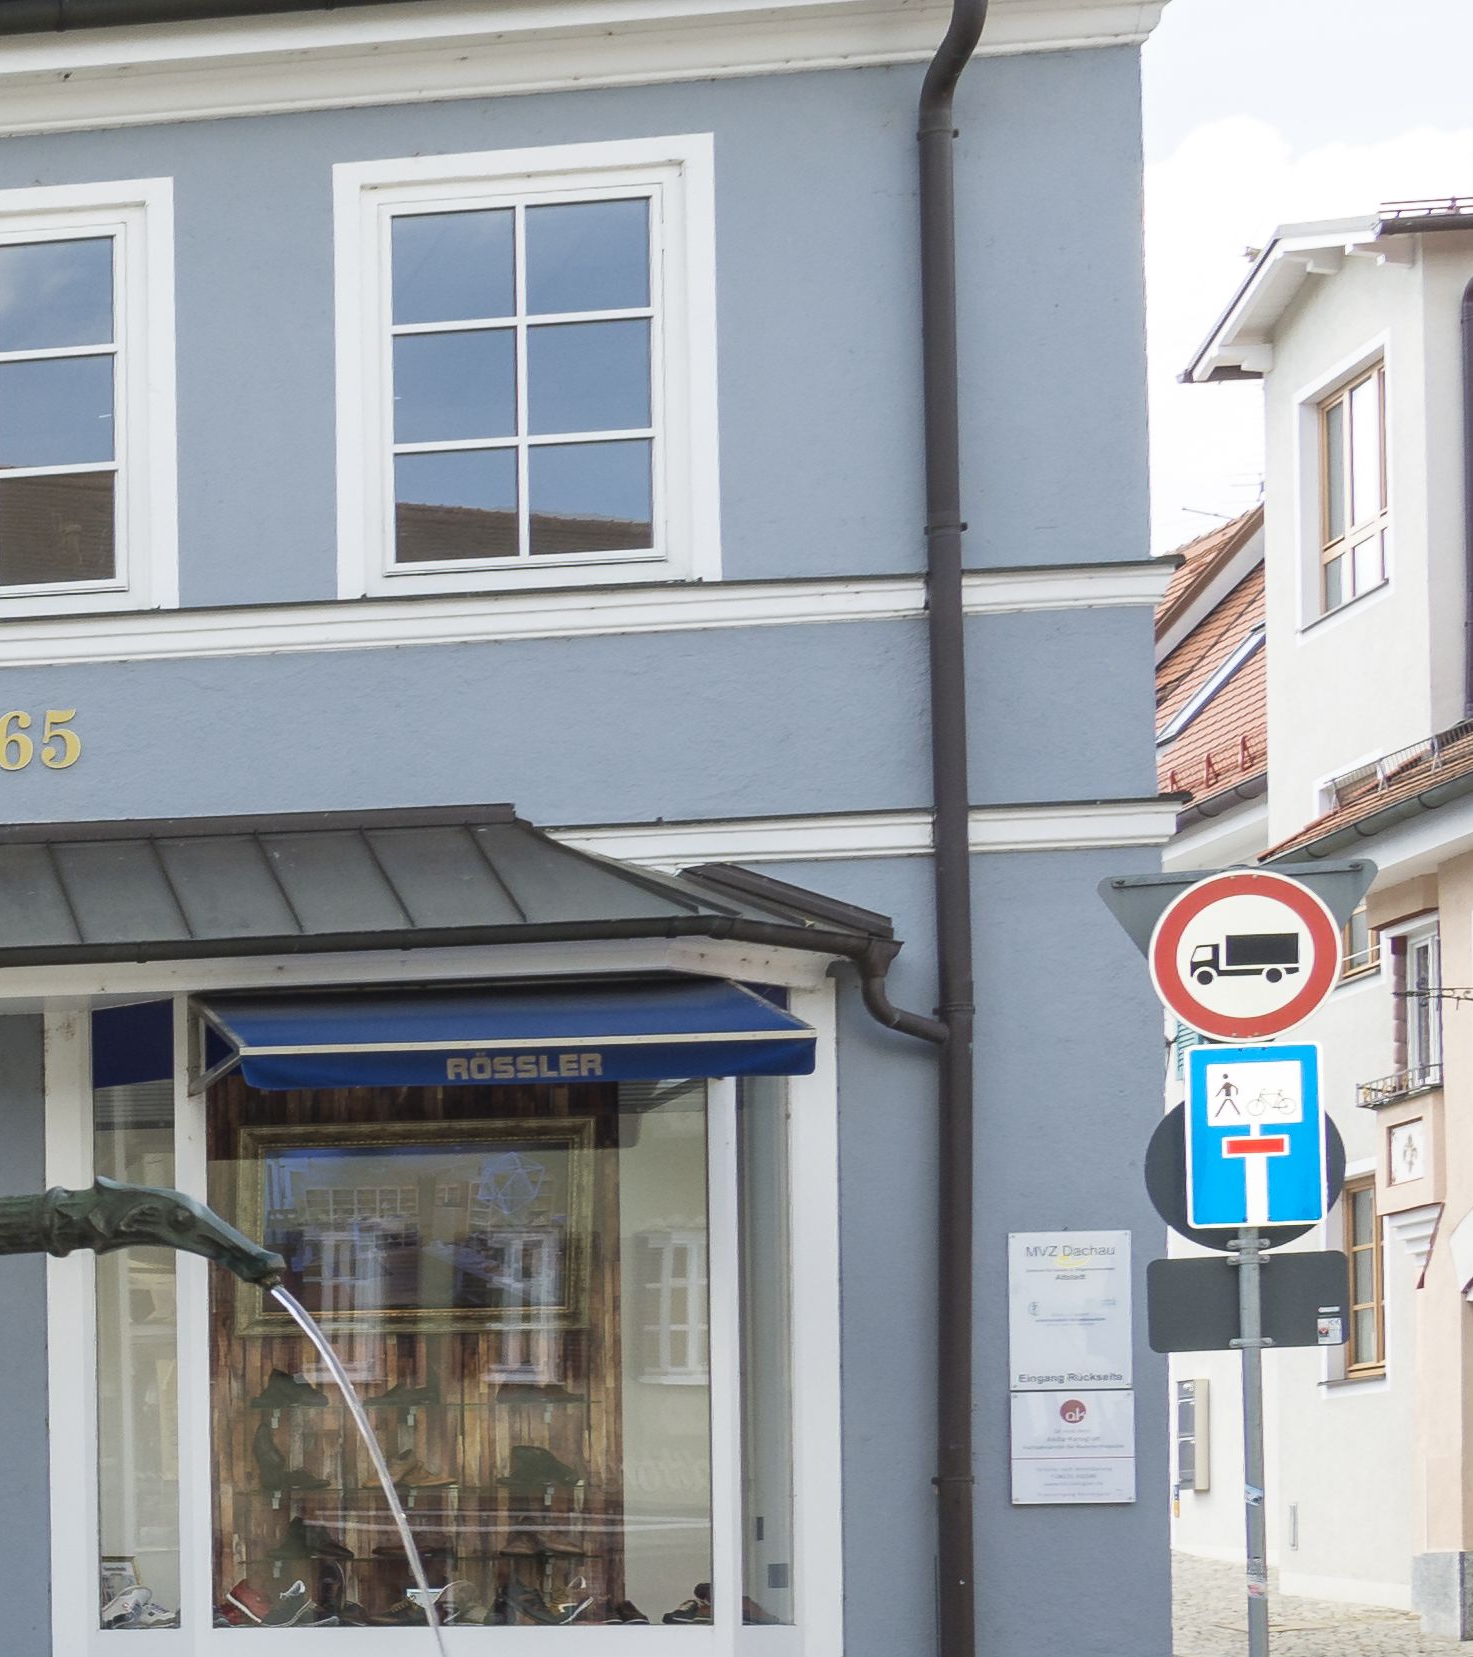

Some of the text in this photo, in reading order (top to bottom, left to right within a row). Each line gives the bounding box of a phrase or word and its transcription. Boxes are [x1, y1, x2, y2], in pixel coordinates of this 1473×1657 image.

[446, 1052, 603, 1081] RÖSSLER
[1025, 1245, 1116, 1257] MVZ Dachau
[1018, 1372, 1123, 1384] Eingang Rückseite
[1065, 1407, 1086, 1422] ak
